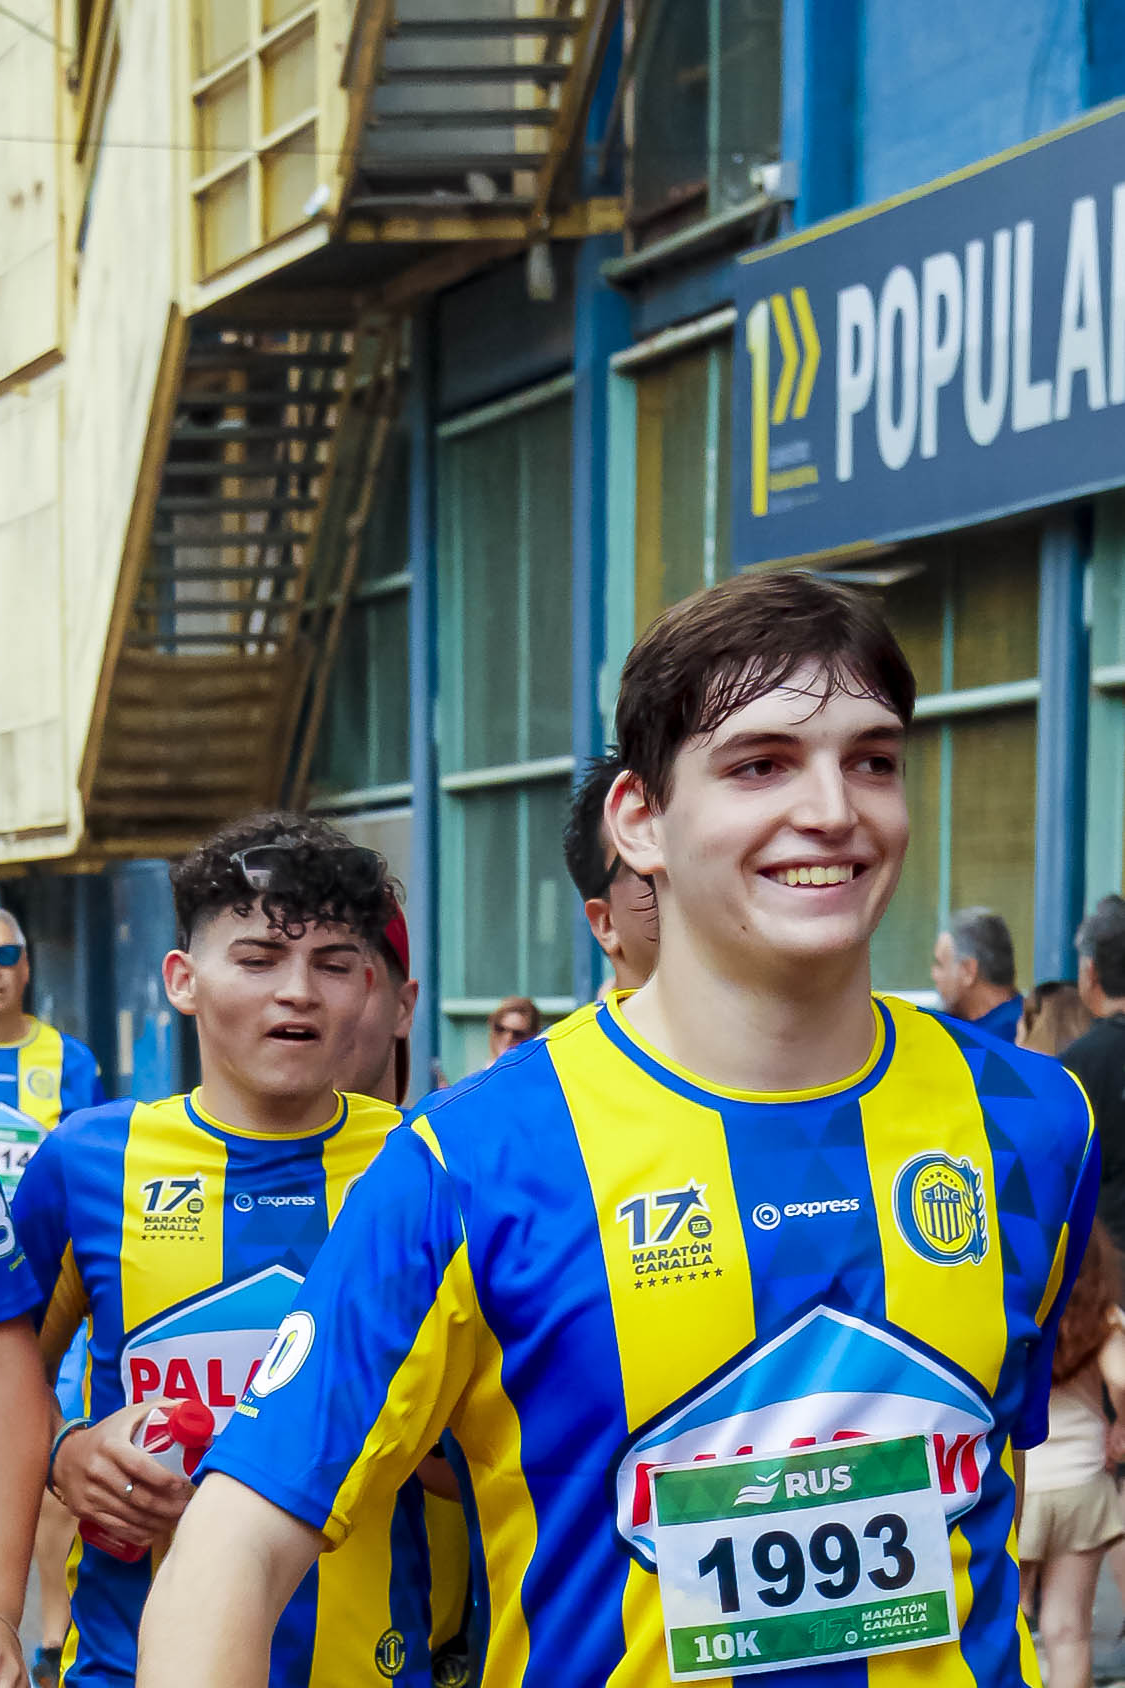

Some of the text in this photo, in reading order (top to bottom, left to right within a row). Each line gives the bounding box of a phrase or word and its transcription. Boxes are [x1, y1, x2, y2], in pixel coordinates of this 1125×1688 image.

[141, 1174, 316, 1213] 17 express
[144, 1215, 201, 1224] MARATÓN
[617, 1179, 860, 1249] 17 express
[144, 1223, 199, 1232] CANALLA
[632, 1241, 712, 1265] MARATÓN
[635, 1254, 713, 1276] CANALLA
[784, 1465, 853, 1498] RUS
[697, 1513, 916, 1613] 1993
[861, 1601, 927, 1621] MARATÓN
[863, 1613, 927, 1631] CANALLA
[693, 1629, 761, 1663] 10K
